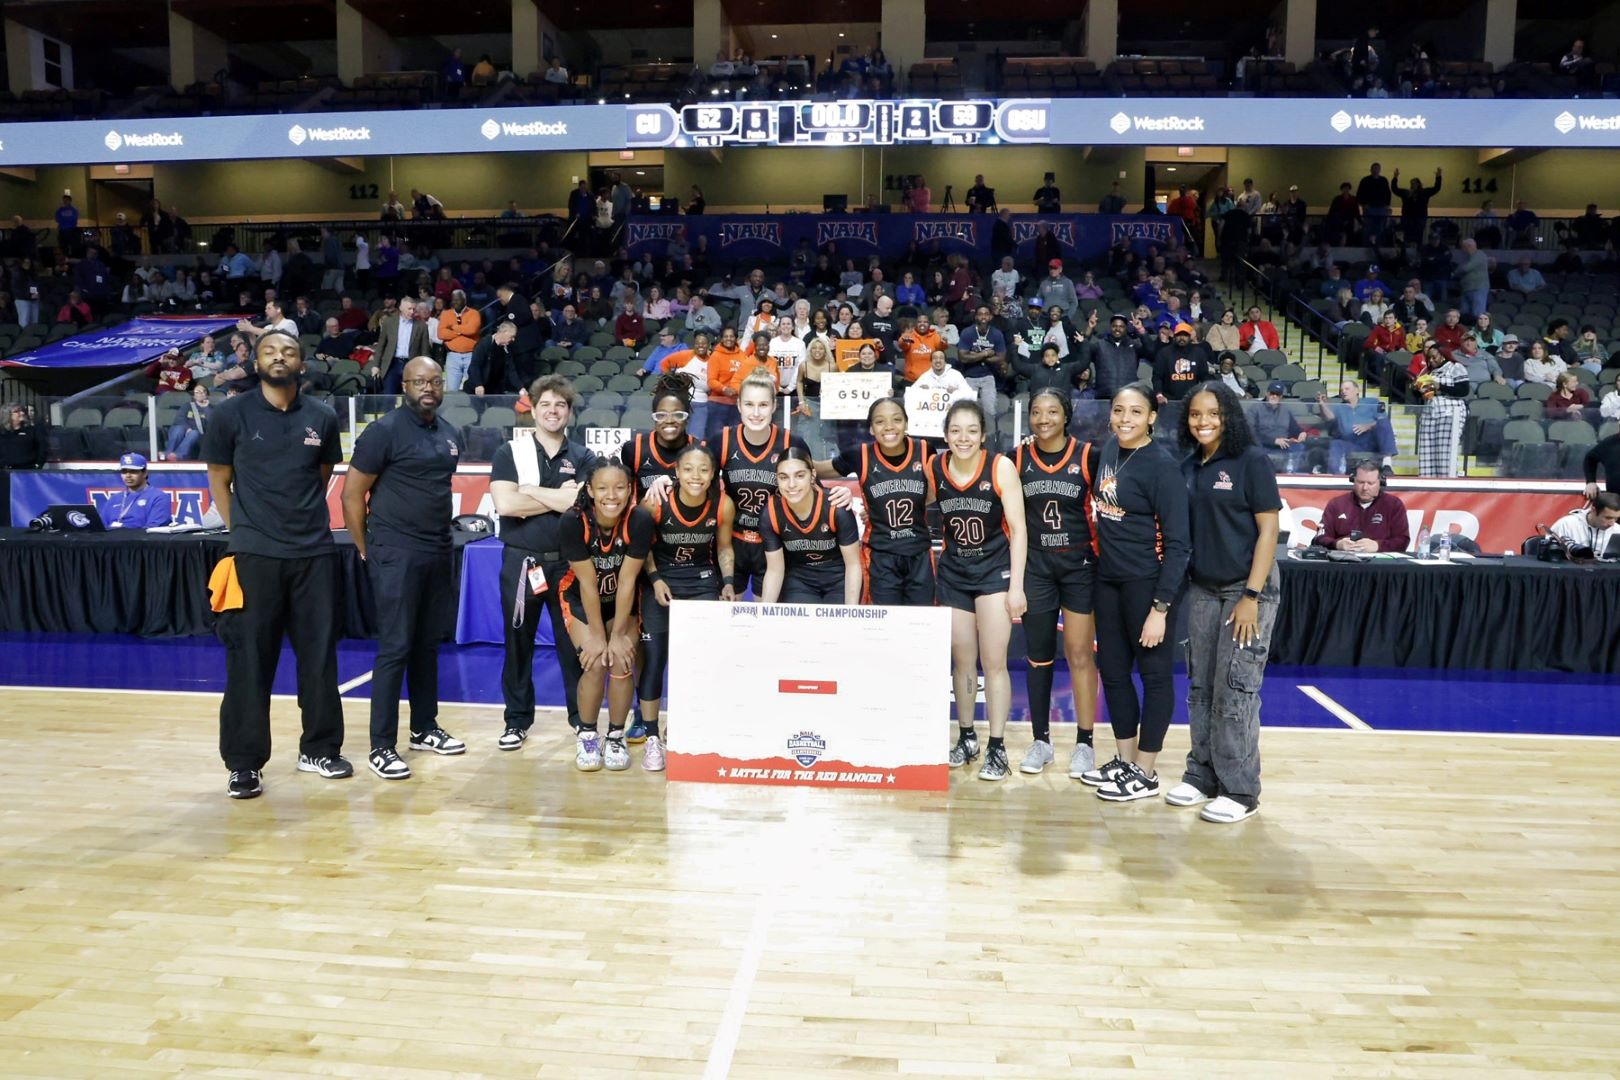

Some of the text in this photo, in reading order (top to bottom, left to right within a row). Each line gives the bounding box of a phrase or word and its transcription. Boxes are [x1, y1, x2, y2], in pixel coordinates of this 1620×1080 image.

[697, 109, 721, 128] 52
[911, 109, 922, 126] 2
[1133, 116, 1204, 131] WestRock
[1354, 114, 1426, 129] WestRock
[1579, 115, 1620, 130] West
[308, 126, 371, 141] WestRock
[502, 121, 568, 136] WestRock
[123, 132, 183, 147] WestRock
[350, 184, 379, 200] 112
[1462, 177, 1498, 194] 114
[722, 223, 781, 247] NAIA
[818, 222, 878, 246] NAIA
[914, 221, 976, 246] NAIA
[1111, 223, 1172, 246] NAIA
[1171, 373, 1194, 381] GSU
[838, 389, 871, 400] GSU
[932, 392, 950, 401] GO
[586, 429, 621, 444] LETS
[1023, 480, 1082, 498] GOVERNORS
[738, 488, 770, 515] 23
[940, 496, 992, 514] GOVERNORS
[886, 498, 914, 528] 12
[1043, 500, 1062, 530] 4
[950, 517, 985, 545] 20
[1040, 533, 1070, 547] STATE
[674, 546, 695, 562] 5
[762, 606, 810, 617] NATIONAL
[815, 607, 888, 619] CHAMPIONSHIP
[730, 767, 883, 783] BATTLE FOR THE RED BANNER
